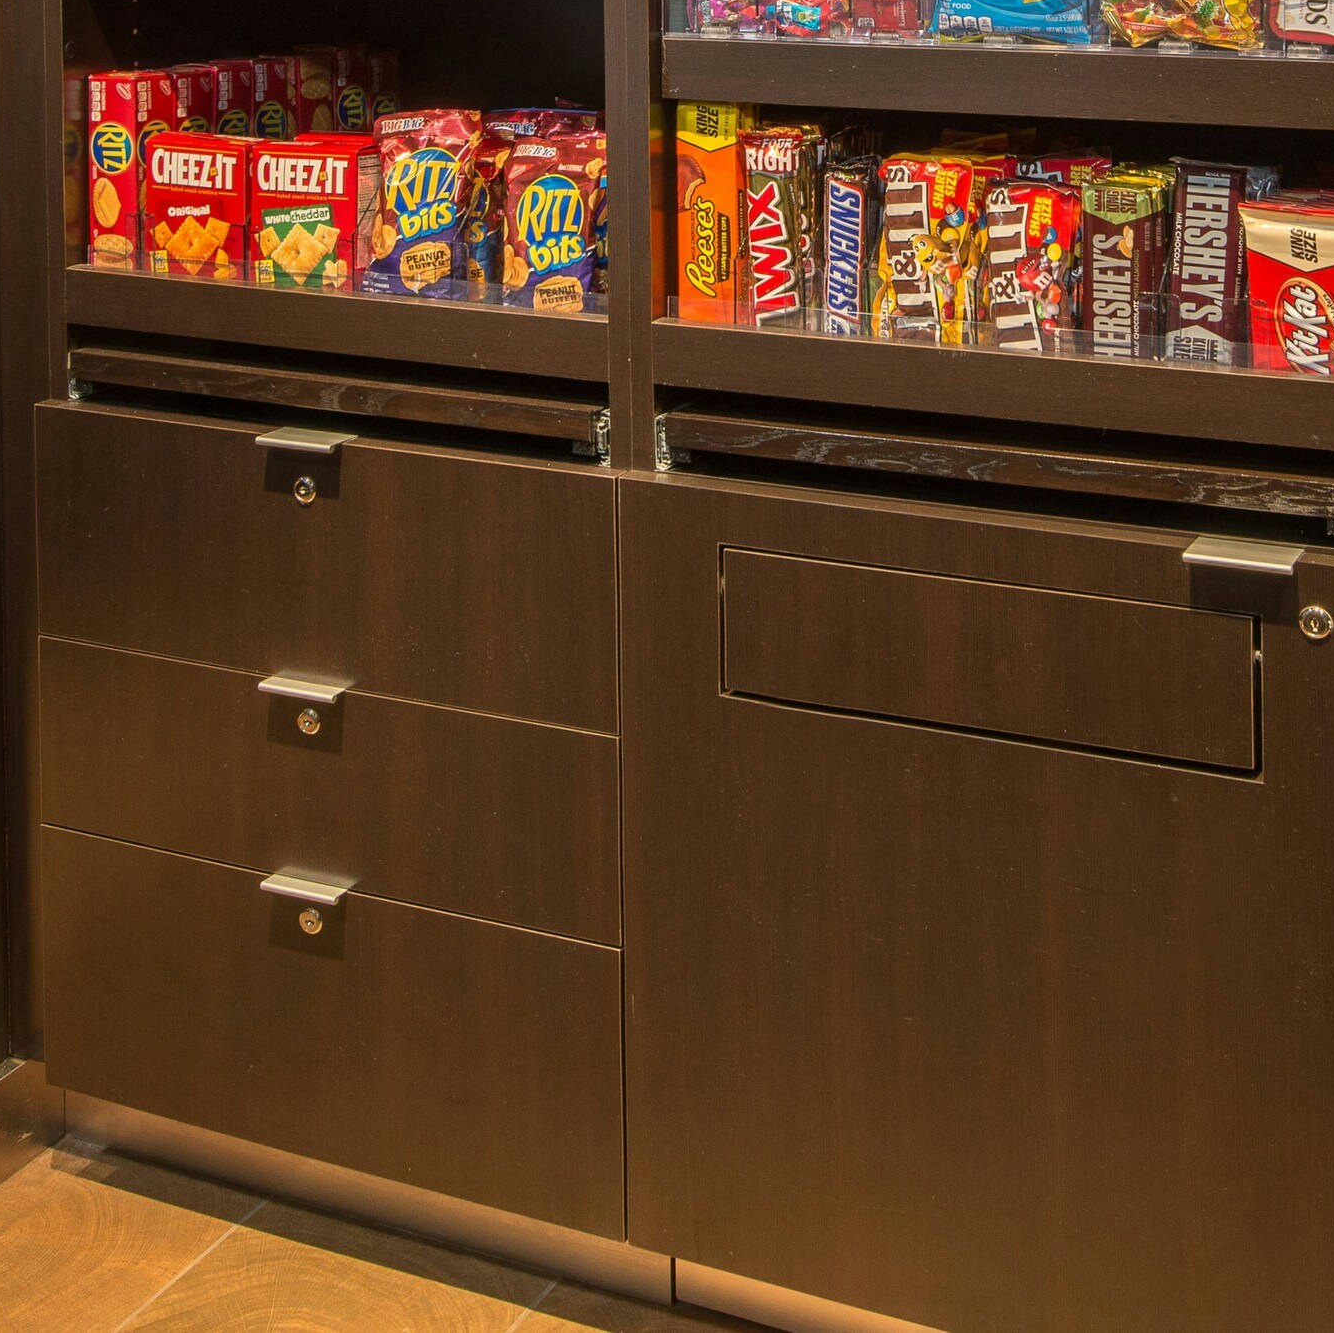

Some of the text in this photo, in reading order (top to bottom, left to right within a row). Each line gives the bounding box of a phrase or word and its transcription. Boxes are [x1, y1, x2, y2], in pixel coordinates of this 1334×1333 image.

[696, 105, 708, 135] KING
[707, 107, 719, 138] SIZE
[98, 124, 130, 171] RITZ
[386, 158, 461, 211] RITZ
[933, 169, 947, 209] SHARE
[945, 171, 958, 198] SIZE
[519, 185, 581, 240] RITZ
[1030, 196, 1045, 237] SHARE
[1042, 197, 1052, 225] SIZE
[406, 252, 446, 264] PEANUT
[685, 196, 716, 298] Reese's
[747, 184, 798, 326] TWIX
[828, 182, 861, 318] SNICKERS
[1172, 230, 1181, 275] CHOCOLATE
[1181, 176, 1231, 323] HERSHEY'S
[1290, 228, 1303, 258] KING
[1304, 232, 1317, 263] SIZE
[538, 285, 577, 298] PEANUT
[541, 294, 578, 305] BUTTER
